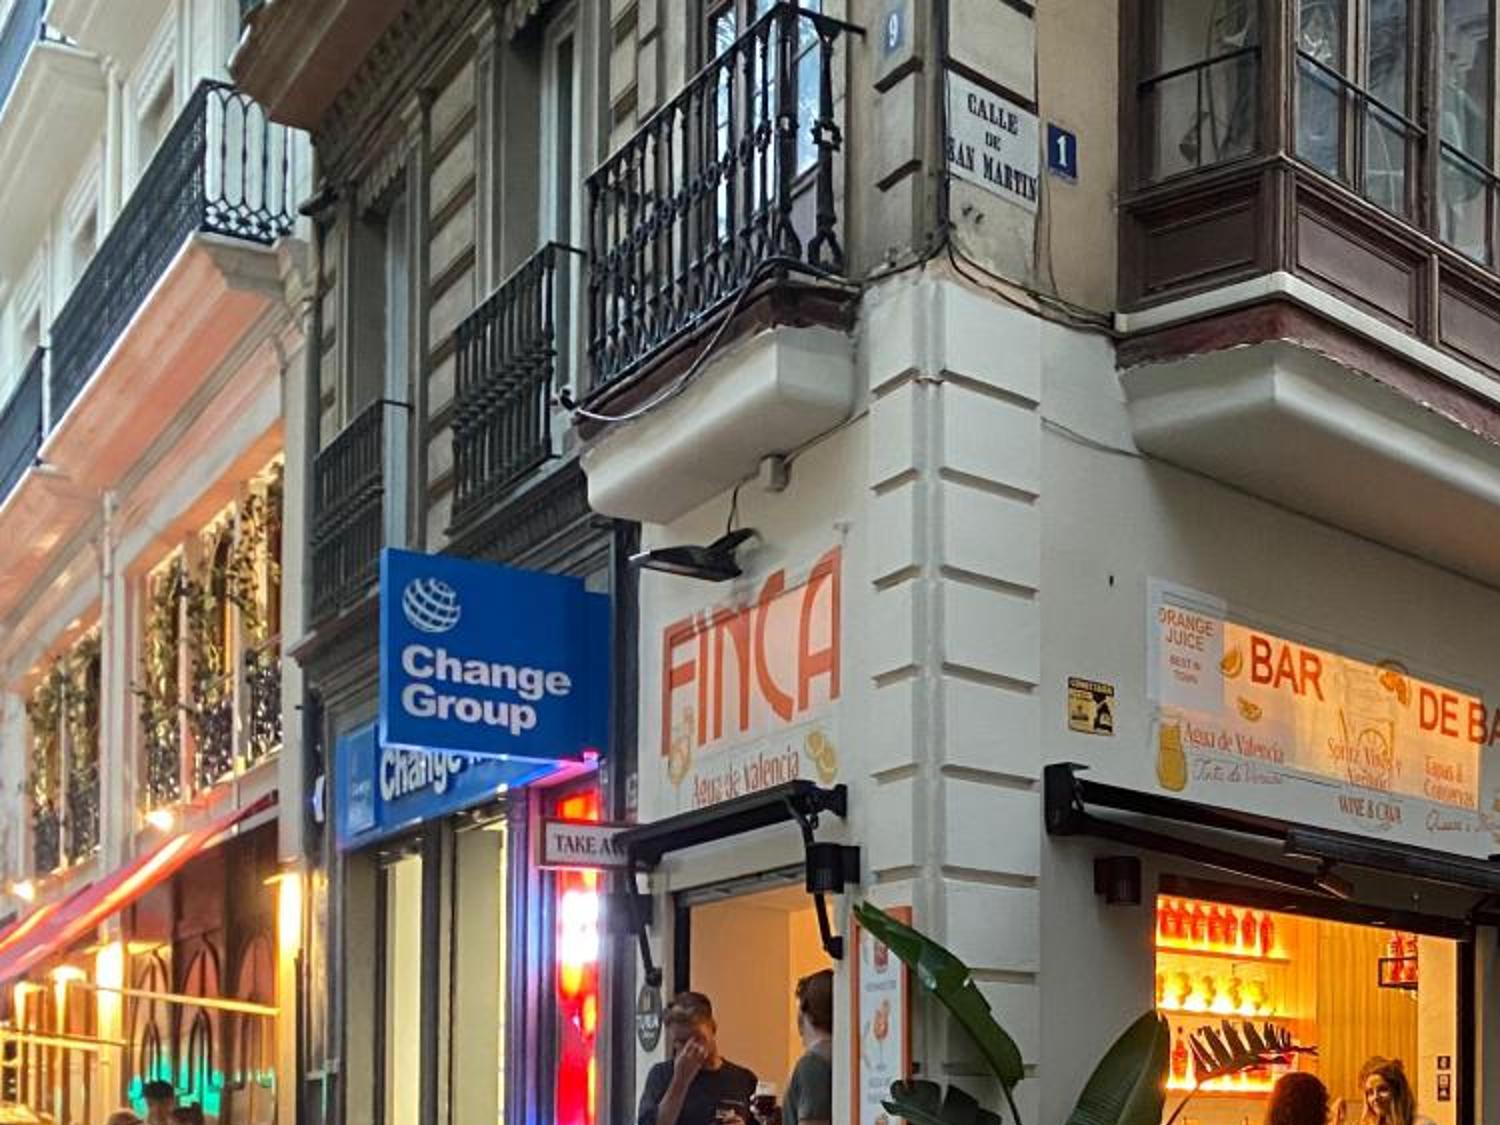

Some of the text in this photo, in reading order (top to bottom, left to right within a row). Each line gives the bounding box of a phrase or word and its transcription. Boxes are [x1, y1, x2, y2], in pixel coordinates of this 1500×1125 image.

[967, 93, 1018, 135] CALLE
[985, 131, 1001, 152] DE
[1056, 135, 1068, 168] 1
[983, 152, 1037, 203] MARTIN
[1158, 607, 1215, 637] ORANGE
[1165, 628, 1205, 652] JUICE
[402, 644, 572, 701] Change
[661, 543, 842, 757] FINCA
[1250, 634, 1325, 702] BAR
[1419, 687, 1459, 738] DE
[402, 683, 538, 736] Group
[743, 744, 800, 793] Valencia
[555, 832, 597, 855] TAKE
